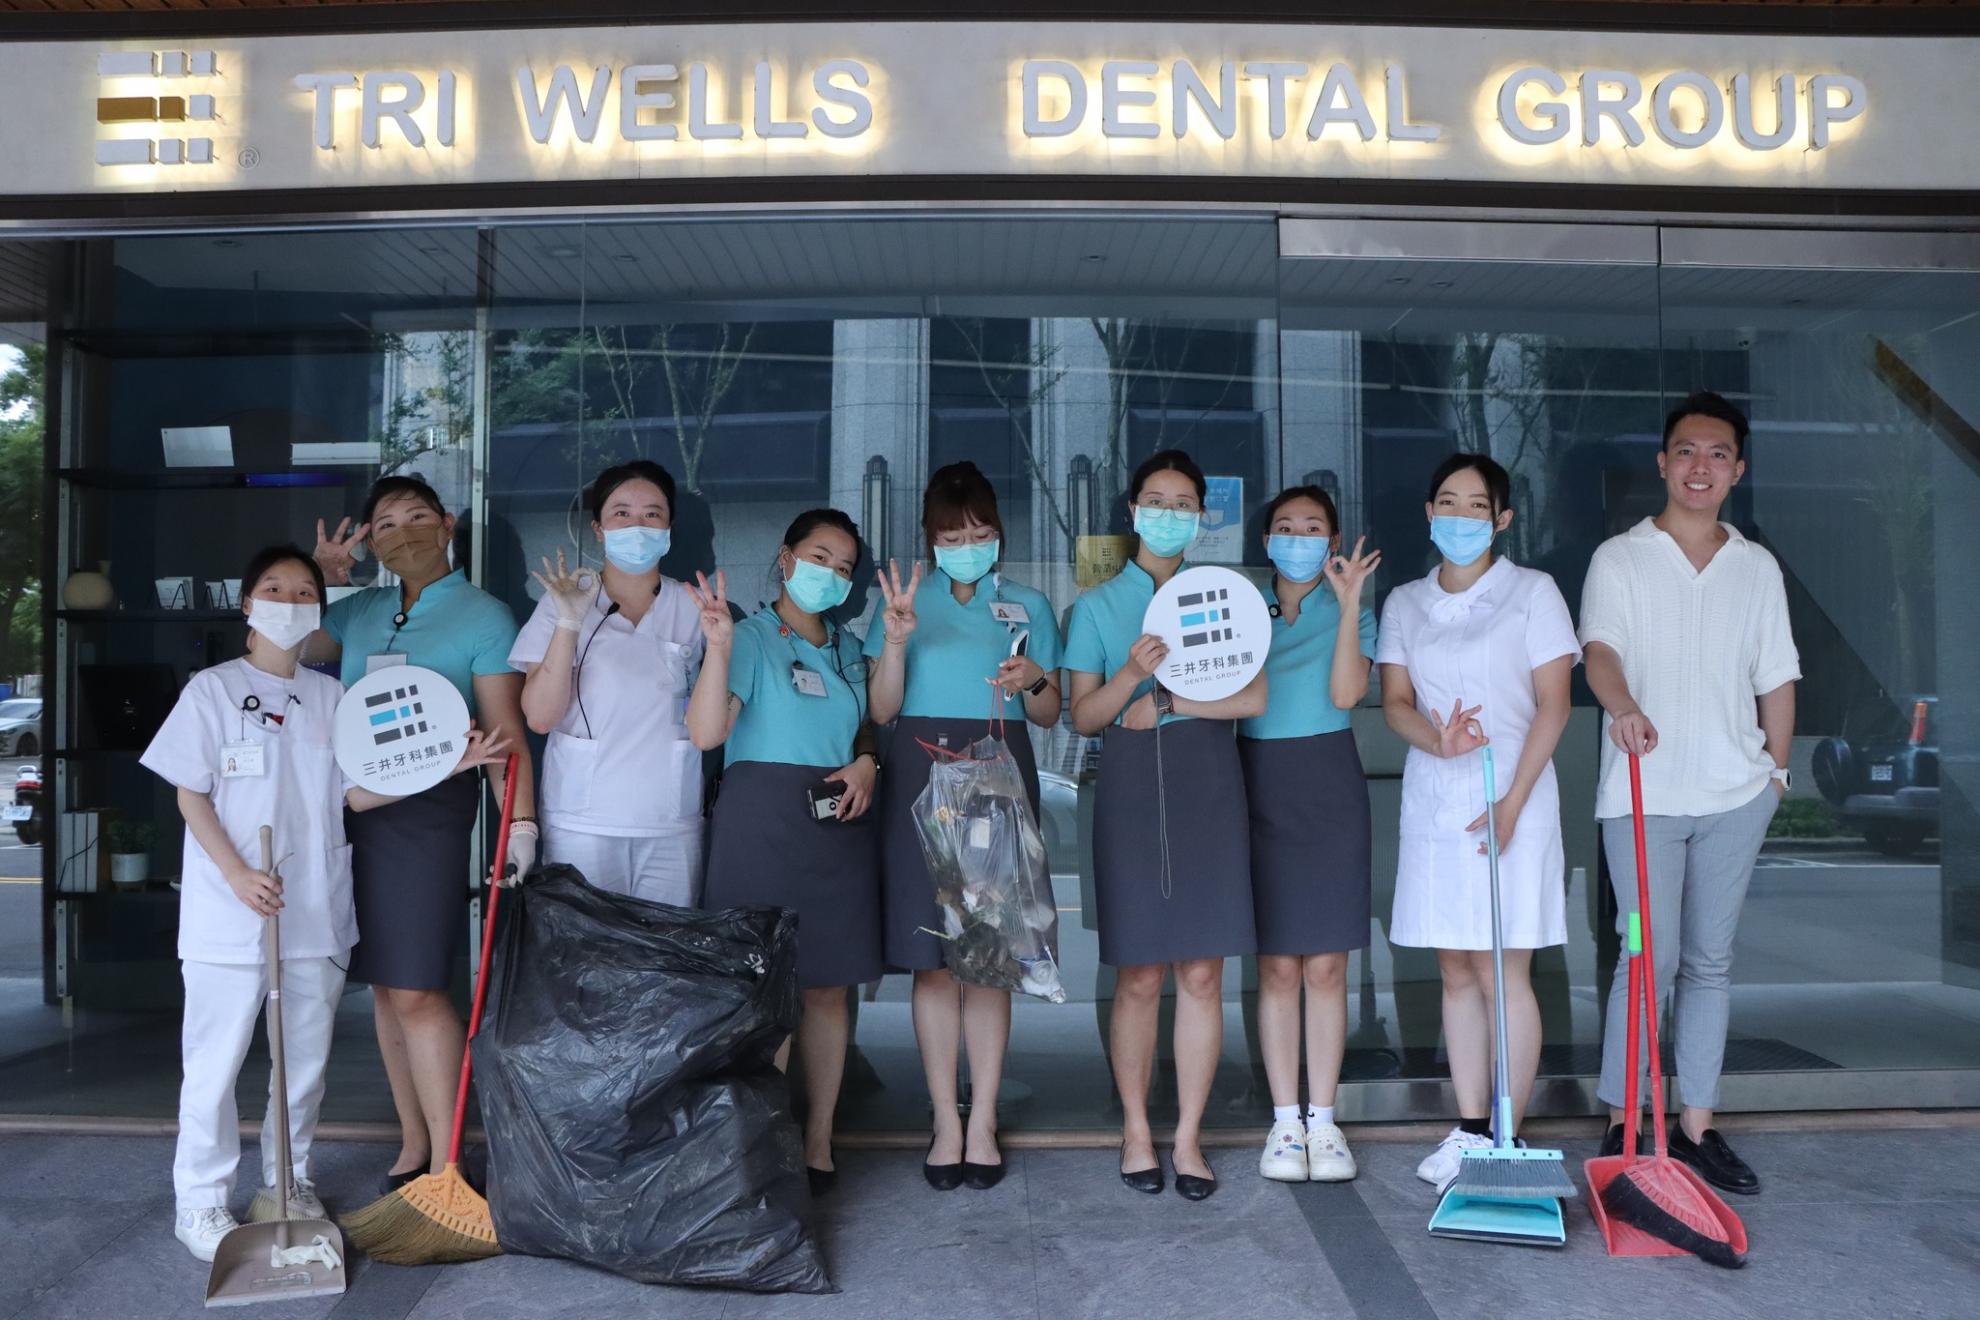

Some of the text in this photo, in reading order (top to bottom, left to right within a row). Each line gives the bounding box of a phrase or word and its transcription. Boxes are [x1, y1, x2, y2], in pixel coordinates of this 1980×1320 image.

[294, 59, 1867, 152] TRI WELLS DENTAL GROUP
[1170, 651, 1253, 677] 三井牙科集團
[1185, 670, 1241, 685] DENTAL GROUP
[363, 740, 454, 776] 三井牙科集團
[381, 760, 441, 782] DENTAL GROUP
